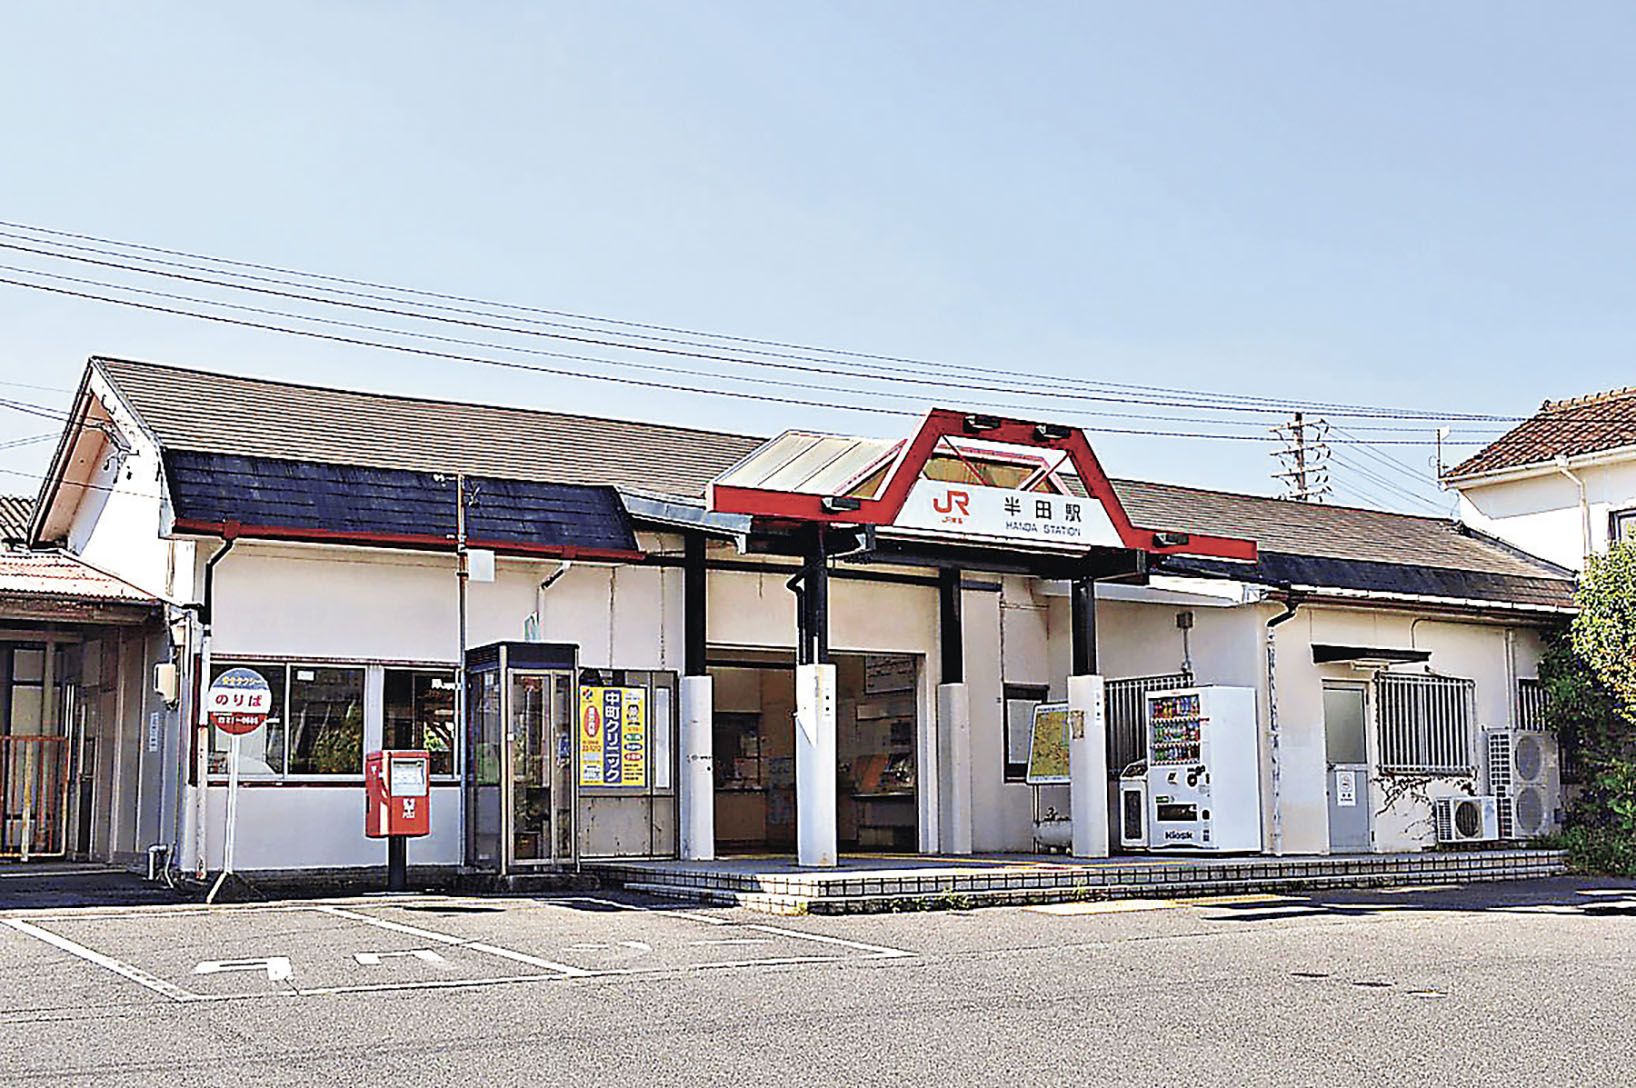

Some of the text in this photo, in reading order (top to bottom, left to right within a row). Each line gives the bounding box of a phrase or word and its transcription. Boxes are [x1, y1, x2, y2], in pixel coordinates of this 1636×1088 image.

[933, 490, 970, 516] JR
[1004, 496, 1082, 523] 半田駅
[1006, 520, 1082, 537] HANDA STATION
[215, 694, 263, 707] のりば
[605, 692, 620, 782] 中町クリニック
[1165, 830, 1193, 840] Kiosk
